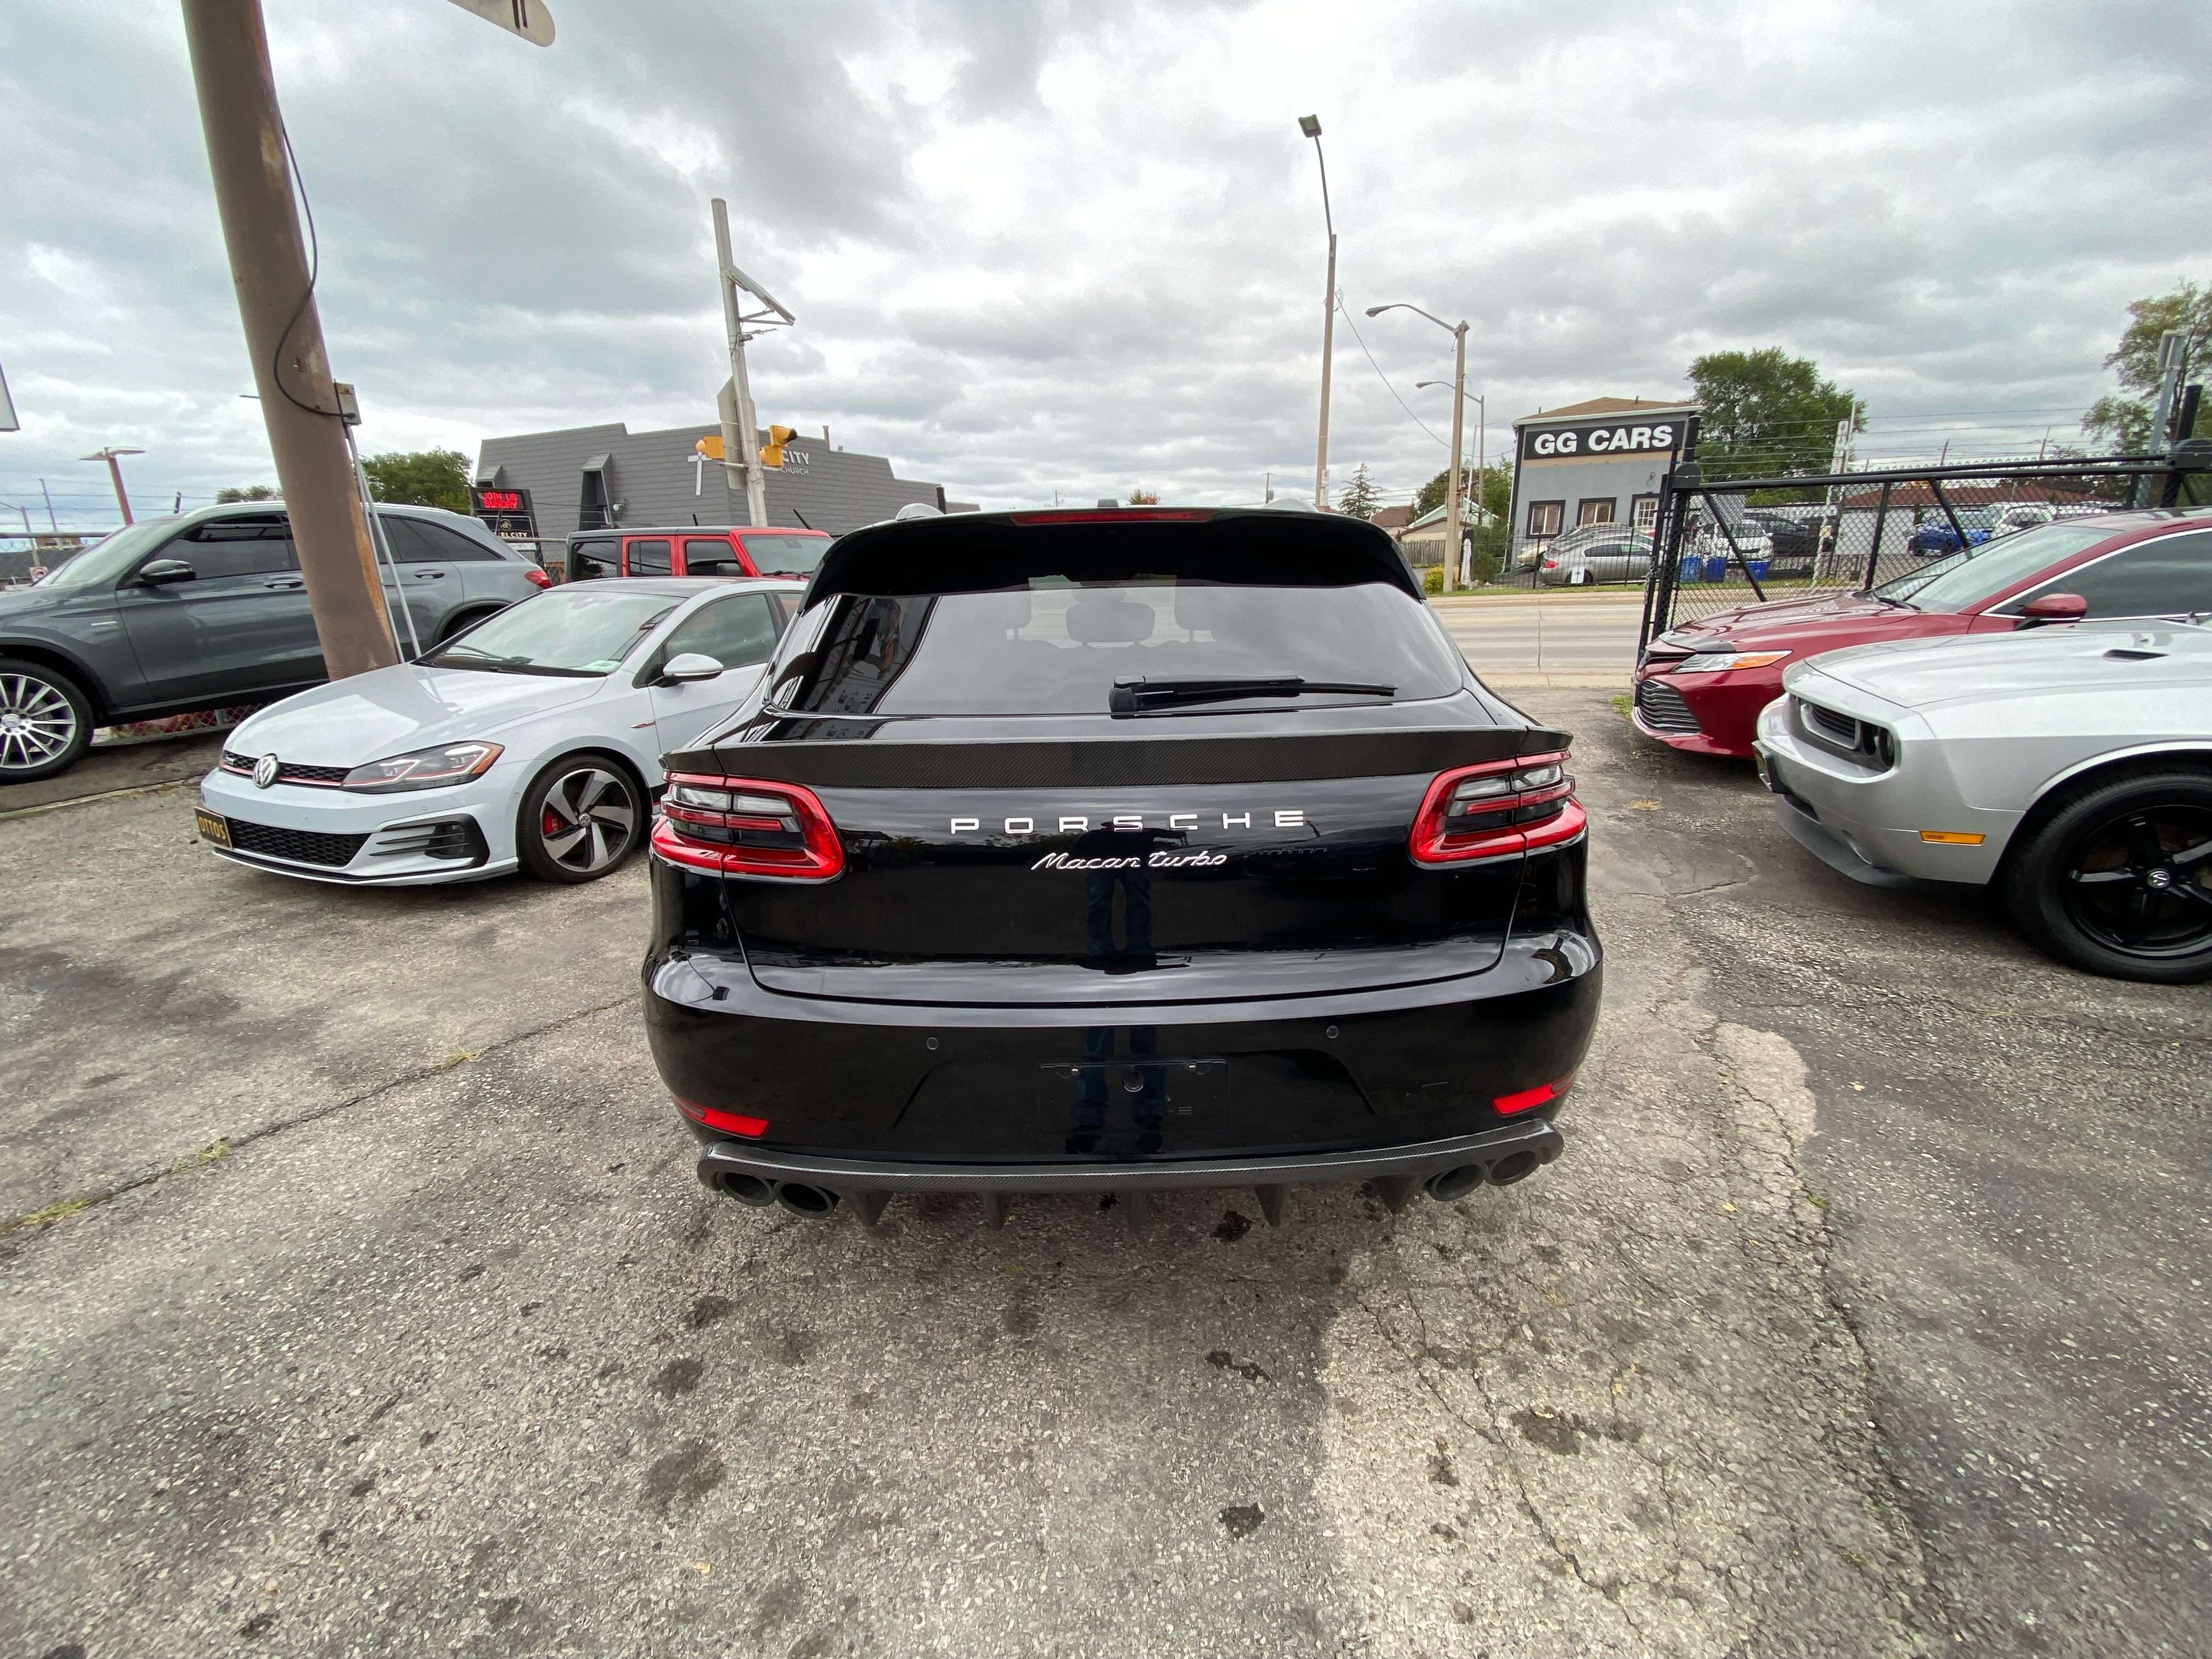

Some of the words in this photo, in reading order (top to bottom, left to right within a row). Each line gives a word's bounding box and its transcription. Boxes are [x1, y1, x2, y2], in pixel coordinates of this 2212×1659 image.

[1534, 432, 1577, 455] GG
[1588, 425, 1672, 451] CARS
[781, 450, 809, 465] CITY
[781, 466, 809, 475] CHURCH
[483, 500, 517, 509] SUNDAY
[951, 810, 1305, 834] PORSCHE
[1031, 852, 1141, 871] Macan
